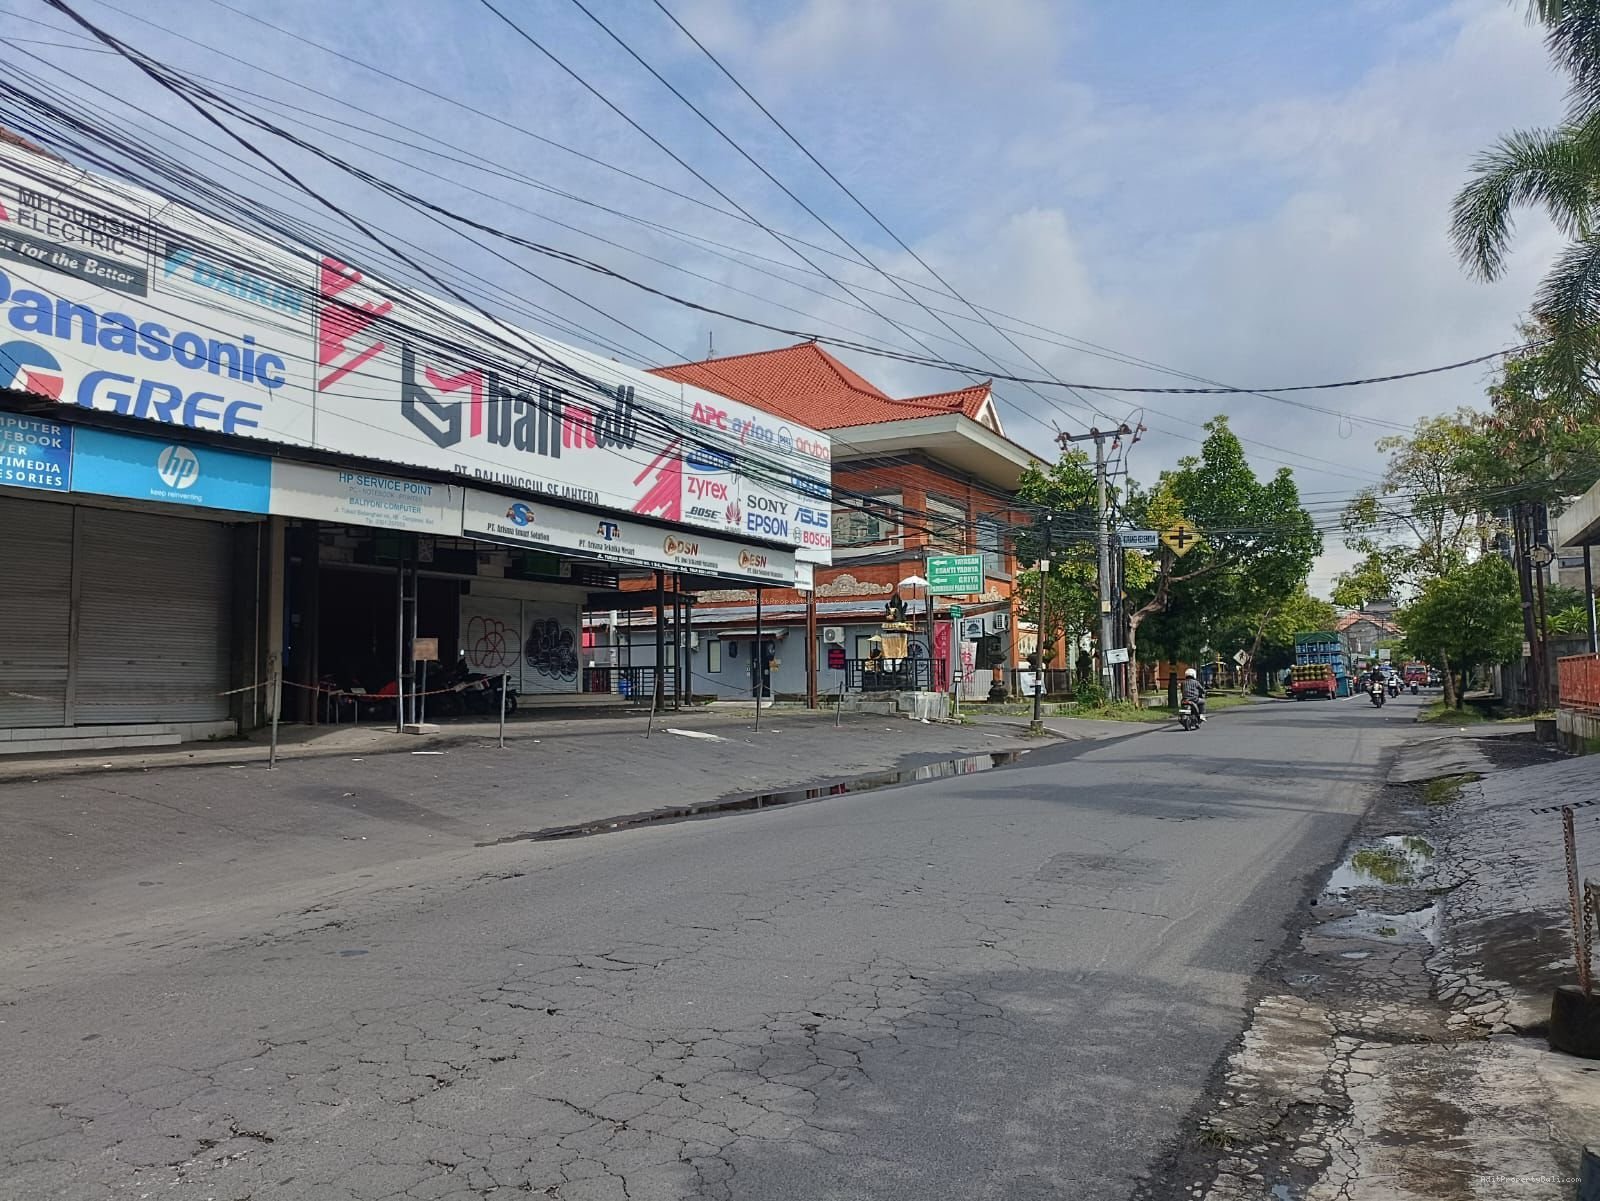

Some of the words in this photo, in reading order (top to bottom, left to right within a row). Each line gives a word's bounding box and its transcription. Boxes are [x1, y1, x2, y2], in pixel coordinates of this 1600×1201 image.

[18, 186, 144, 243] MITSUBISHI
[17, 206, 126, 256] ELECTRIC
[19, 242, 48, 259] for
[52, 253, 78, 269] the
[84, 258, 135, 284] Better
[192, 259, 303, 317] DAIKIN
[77, 370, 263, 434] GREE
[691, 401, 728, 430] APC
[796, 437, 829, 459] aruba
[162, 445, 196, 488] hp
[150, 488, 166, 497] keep
[167, 491, 202, 502] reinventing
[339, 472, 354, 483] HP
[356, 475, 401, 491] SERVICE
[403, 483, 432, 496] POINT
[687, 476, 728, 501] zyrex
[384, 502, 422, 514] COMPUTER
[686, 506, 721, 519] BOSE
[747, 494, 788, 515] SONY
[487, 522, 496, 531] PT.
[747, 512, 788, 537] EPSON
[794, 507, 828, 528] ASUS
[803, 531, 831, 548] BOSCH
